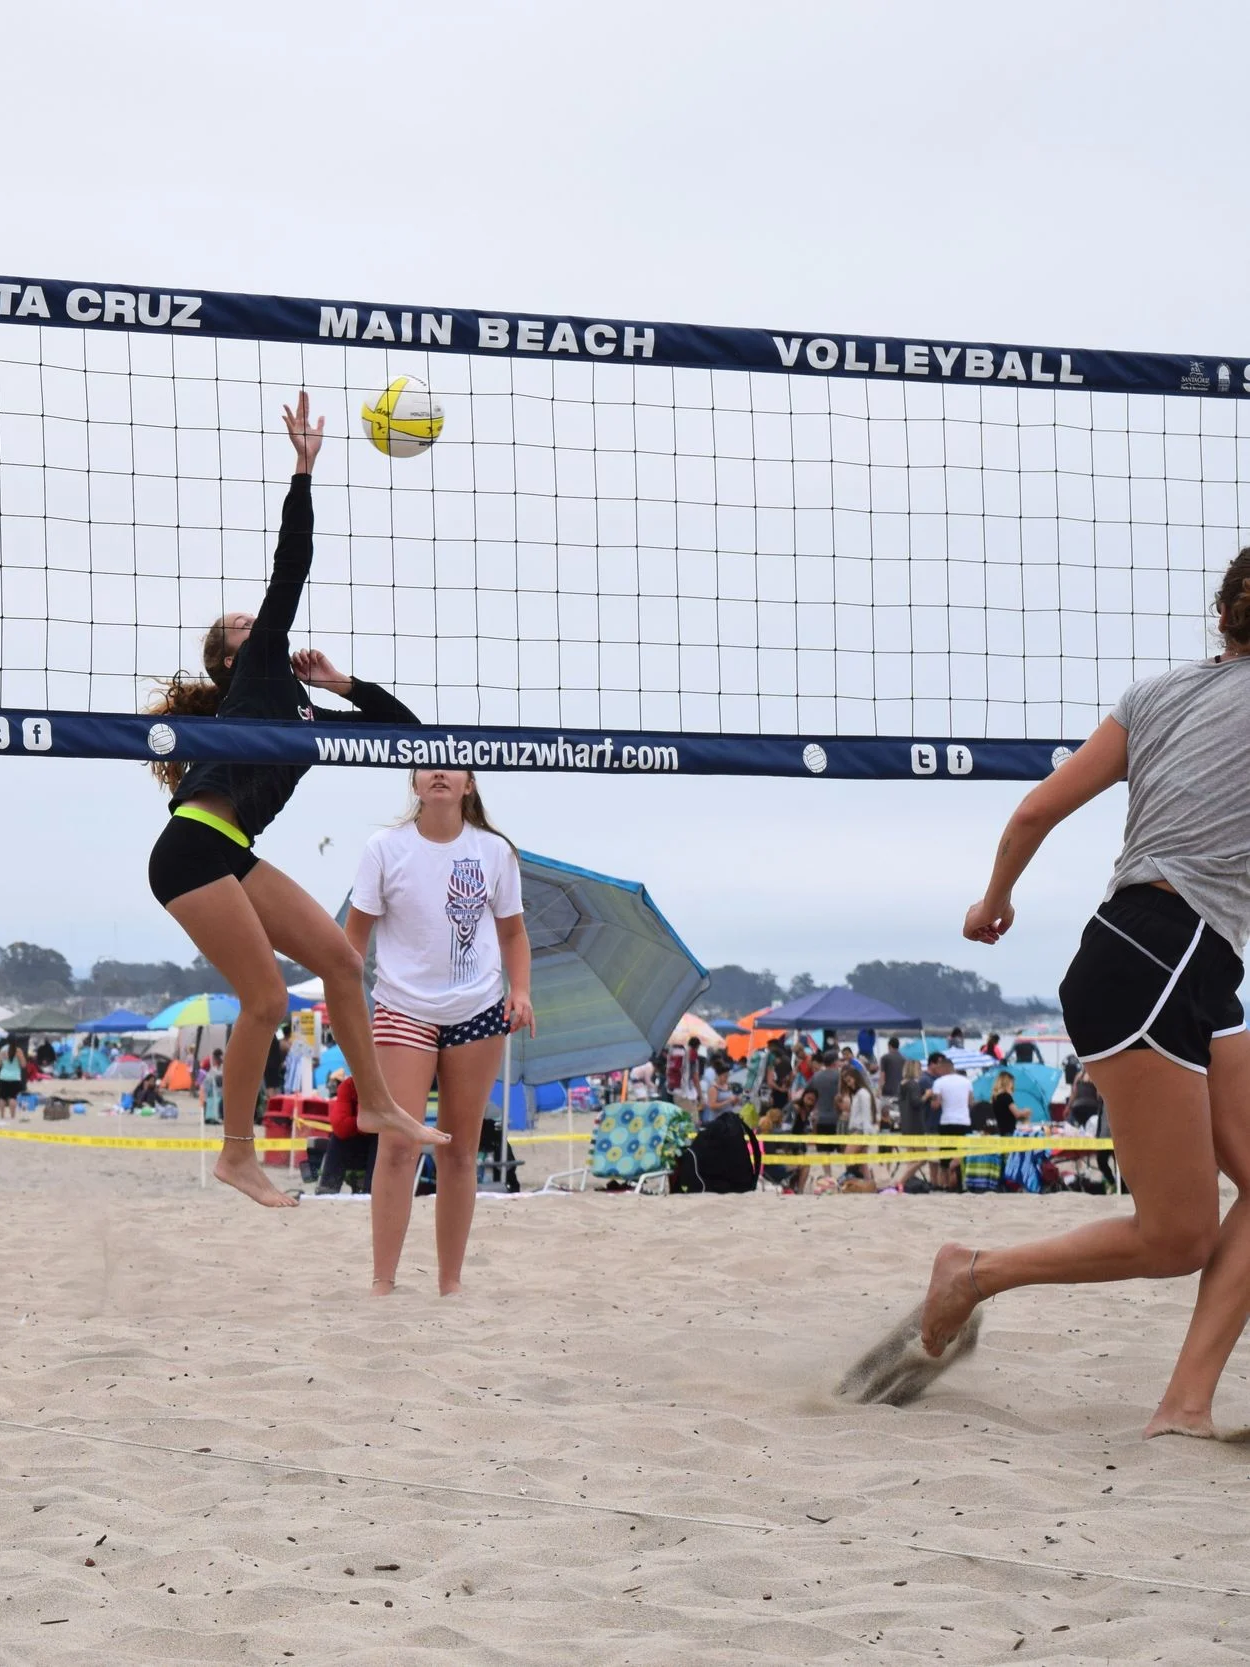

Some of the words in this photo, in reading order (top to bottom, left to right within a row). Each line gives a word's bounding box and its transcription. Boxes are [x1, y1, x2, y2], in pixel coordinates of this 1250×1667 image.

[66, 288, 202, 328] CRUZ
[319, 306, 452, 345] MAIN
[478, 317, 654, 357] BEACH
[773, 336, 1084, 384] VOLLEYBALL
[315, 734, 678, 771] www.santacruzwharf.com
